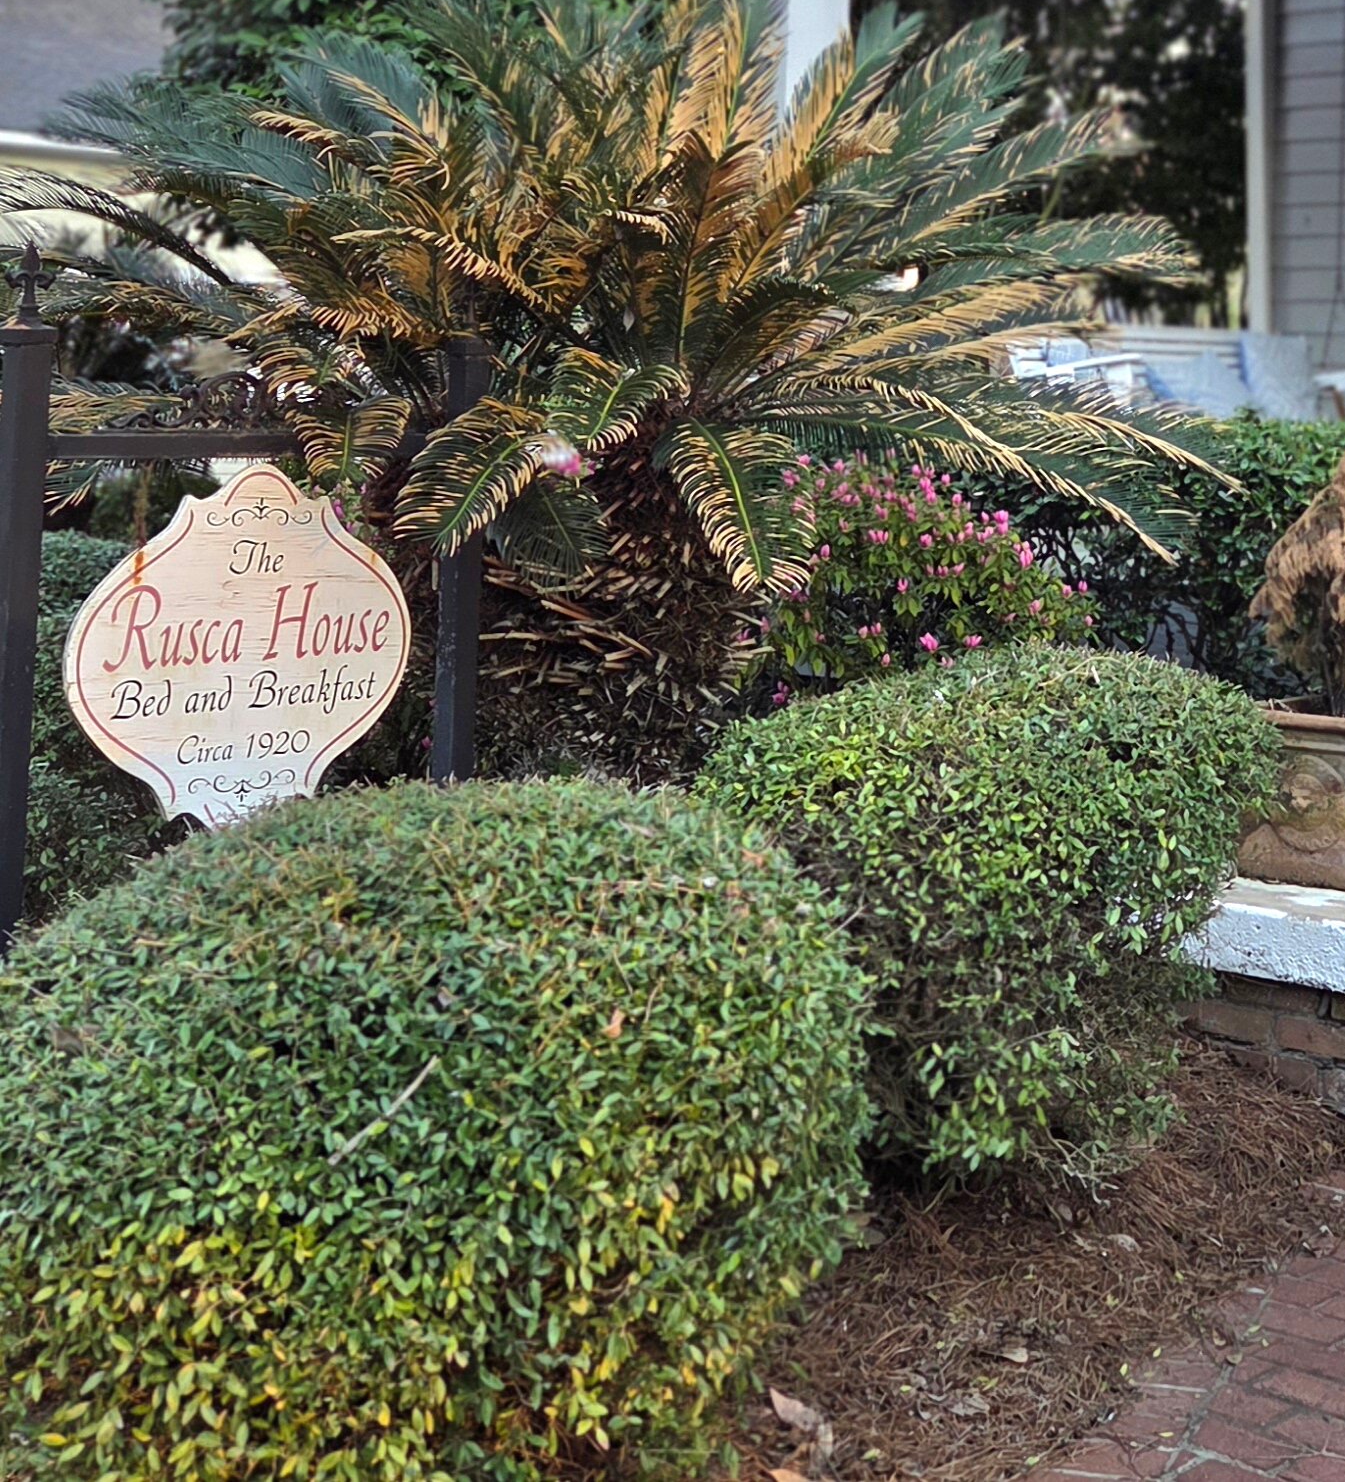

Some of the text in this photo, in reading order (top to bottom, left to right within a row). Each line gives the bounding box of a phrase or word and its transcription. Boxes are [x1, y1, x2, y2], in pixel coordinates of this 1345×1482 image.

[229, 540, 284, 575] The
[102, 581, 390, 673] Rusca House
[110, 665, 377, 720] Bed and Breakfast
[176, 729, 311, 765] Circa 1920
